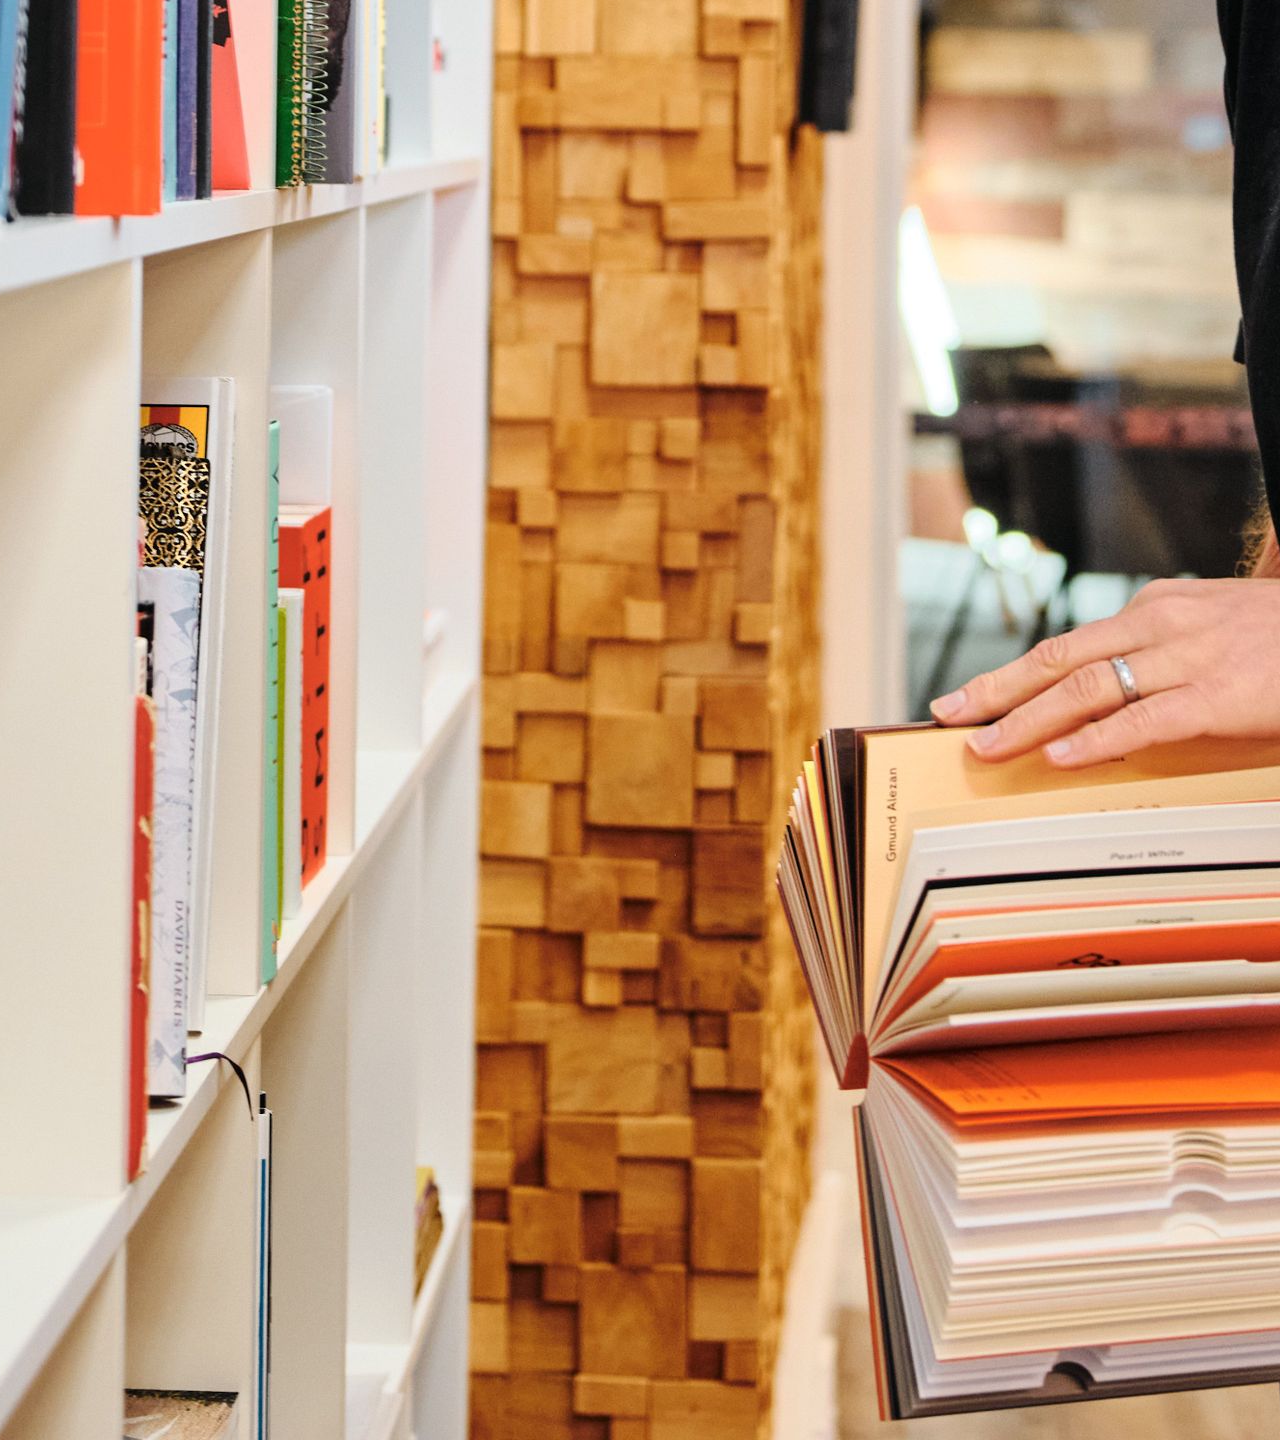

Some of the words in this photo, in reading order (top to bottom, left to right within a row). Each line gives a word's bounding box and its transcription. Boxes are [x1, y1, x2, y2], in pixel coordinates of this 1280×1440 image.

[887, 767, 897, 811] Alezan
[886, 816, 897, 862] Gmund
[175, 900, 184, 954] DAVID
[174, 962, 182, 1027] HARRIS
